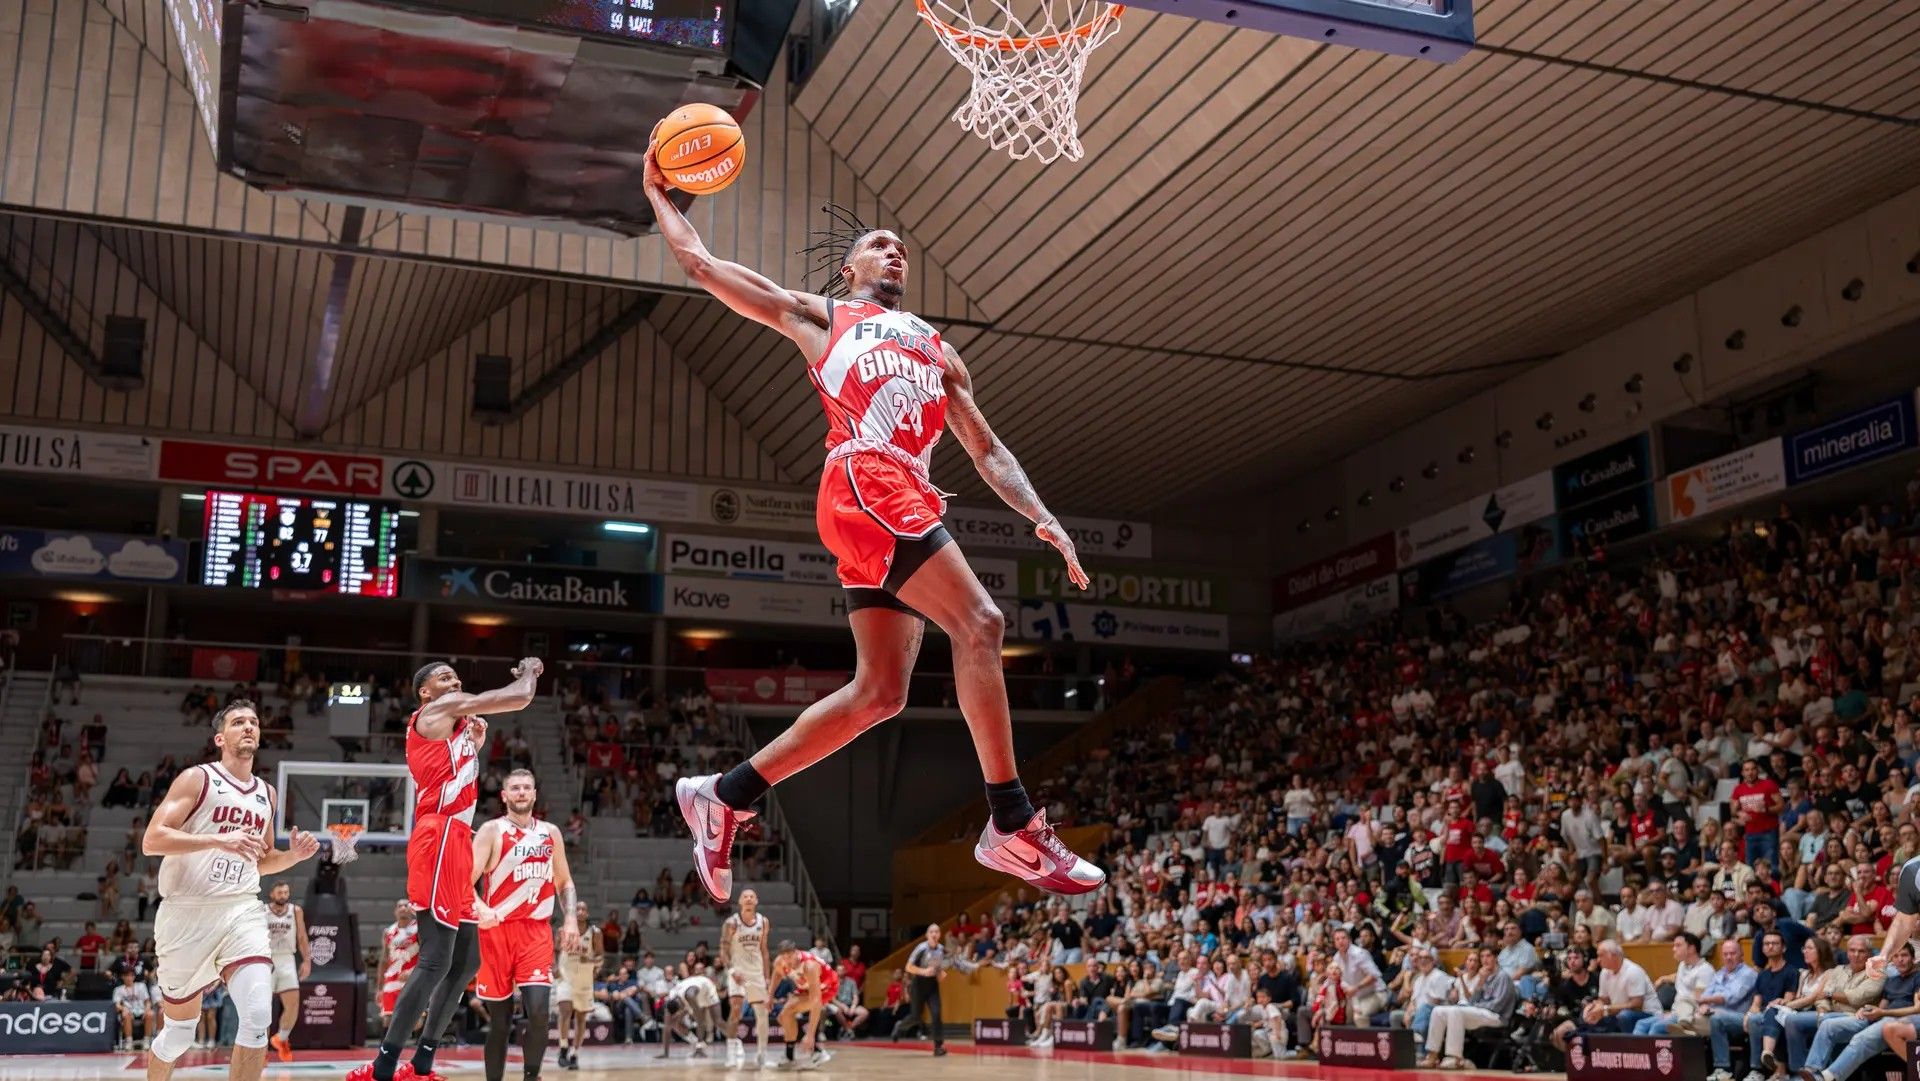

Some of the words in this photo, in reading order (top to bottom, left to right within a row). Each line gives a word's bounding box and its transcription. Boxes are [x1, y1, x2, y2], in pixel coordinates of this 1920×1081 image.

[857, 349, 946, 400] GIRONA
[892, 392, 924, 438] 24
[1803, 419, 1894, 466] mineralia
[224, 452, 380, 489] SPAR
[564, 479, 634, 513] TULSÀ
[672, 540, 784, 571] Panella
[484, 569, 628, 607] CaixaBank
[674, 587, 730, 609] Kave
[212, 805, 265, 831] UCAM
[209, 857, 244, 884] 99
[513, 861, 553, 884] GIRONA
[0, 1006, 107, 1035] ndesa
